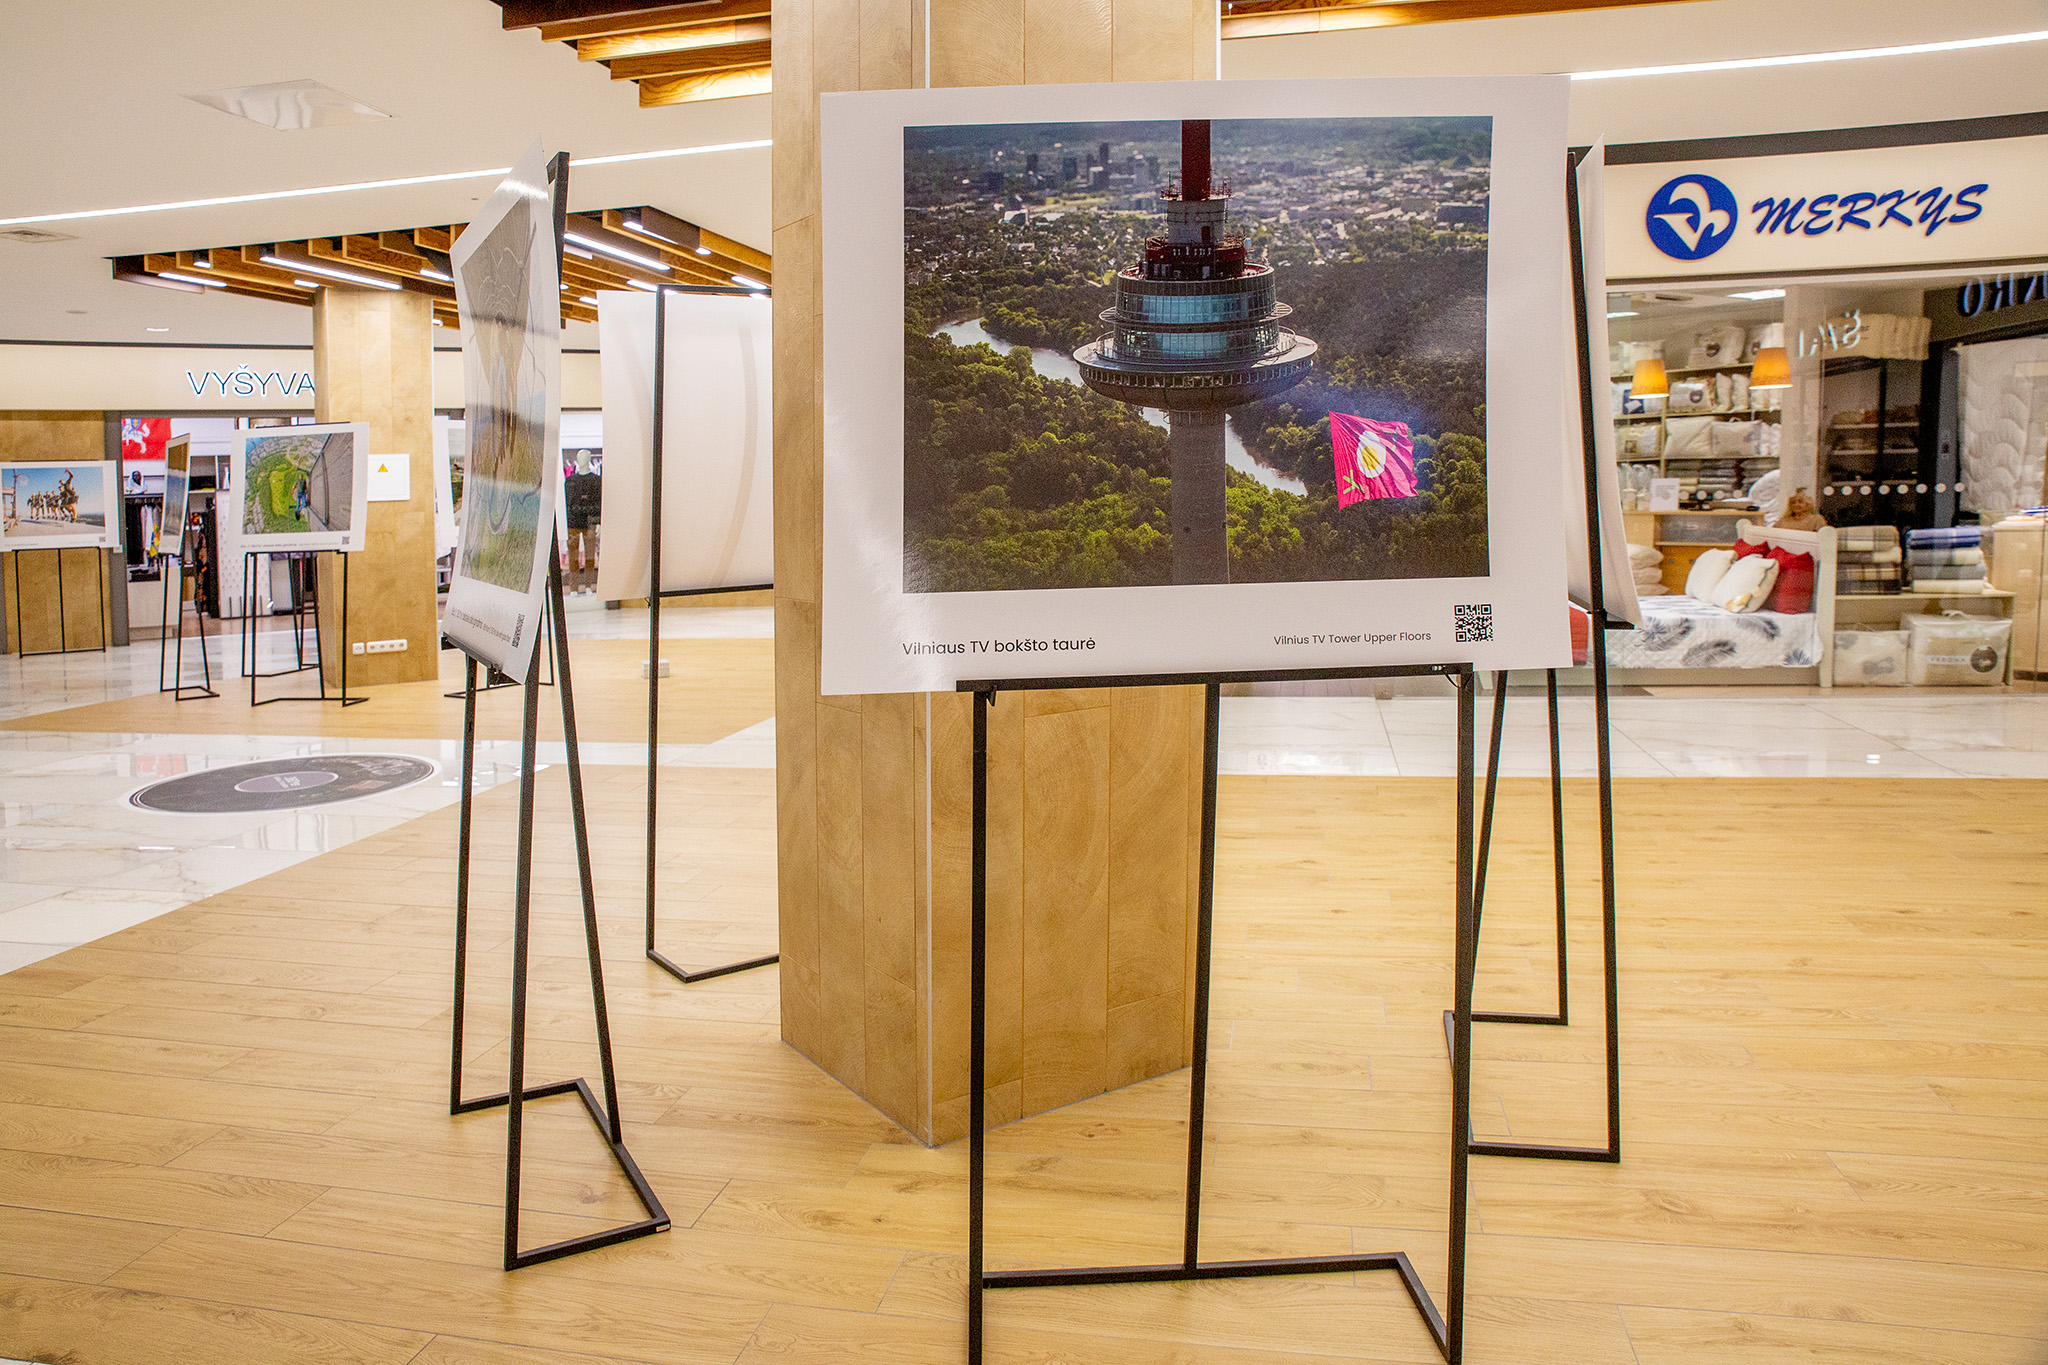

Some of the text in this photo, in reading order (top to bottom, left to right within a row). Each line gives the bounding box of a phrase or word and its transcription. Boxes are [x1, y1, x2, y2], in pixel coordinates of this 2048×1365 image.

[1752, 183, 1989, 236] MERKYS
[187, 364, 315, 396] VYŠYVA
[902, 637, 1096, 655] Vilniaus TV bokšto taurė
[1273, 631, 1432, 645] Vilnius TV Tower Upper Floors
